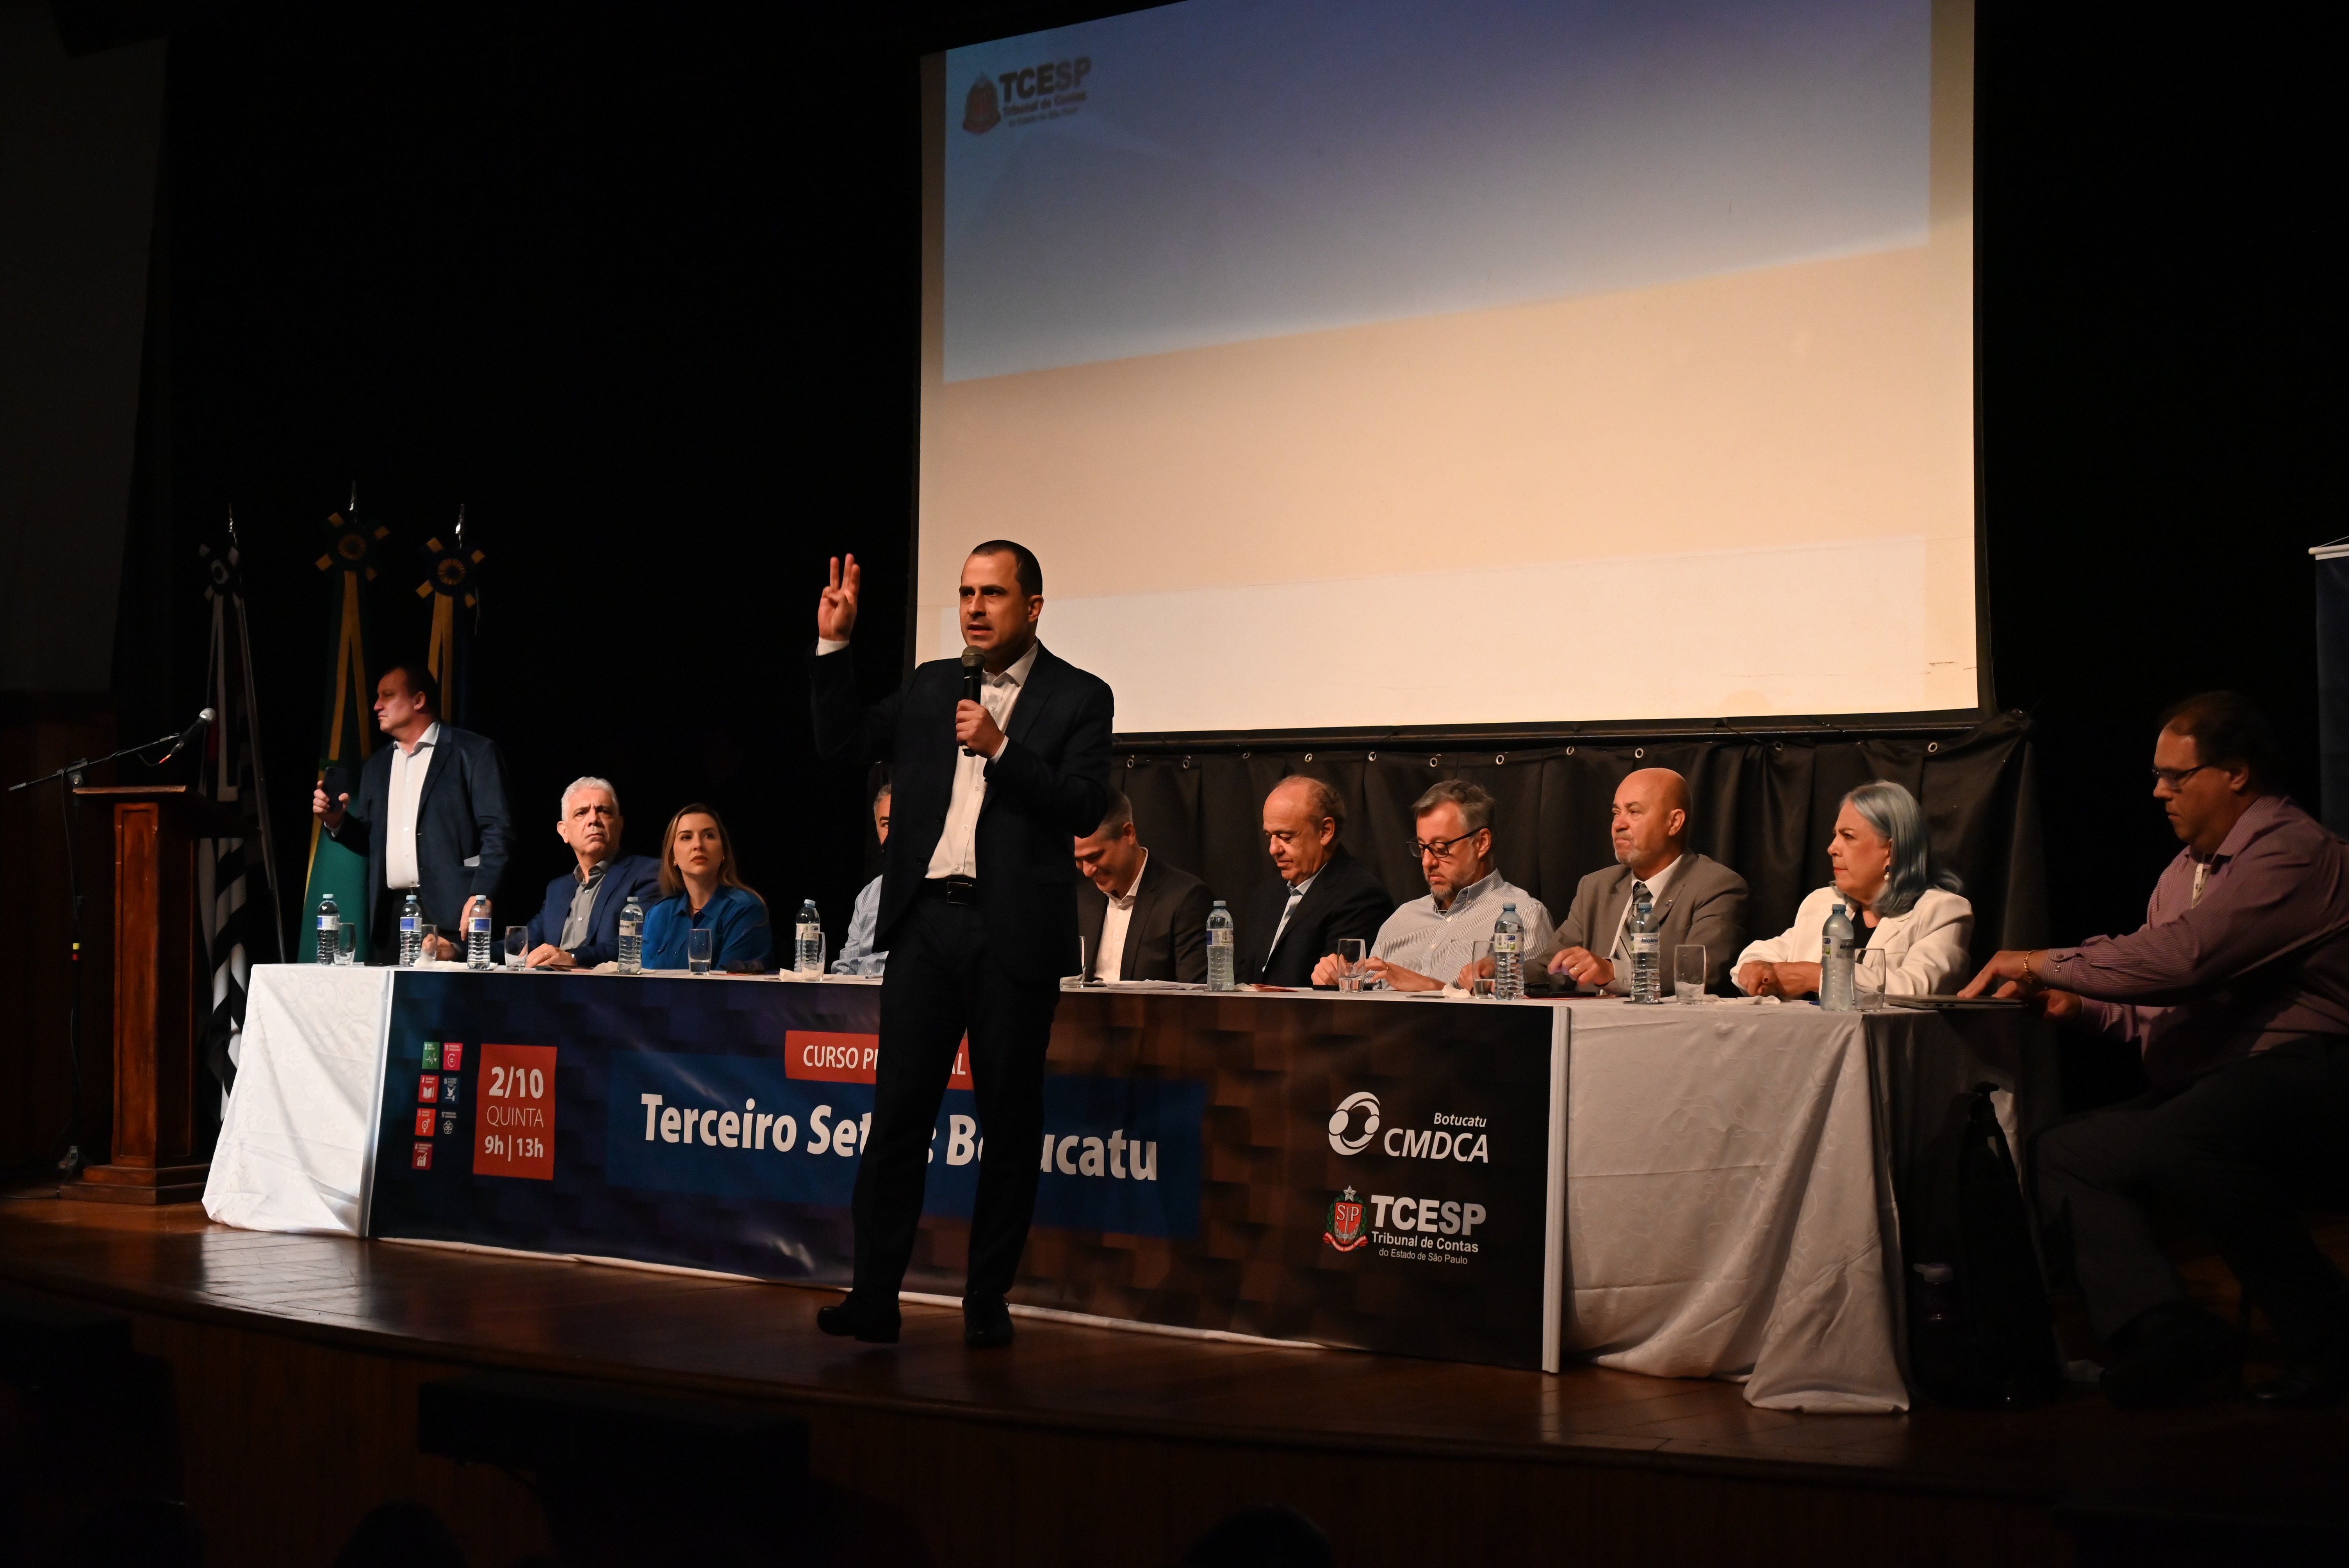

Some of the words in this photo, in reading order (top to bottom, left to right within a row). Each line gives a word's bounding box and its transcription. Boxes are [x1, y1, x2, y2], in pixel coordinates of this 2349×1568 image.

[999, 57, 1092, 103] TCESP
[803, 1045, 858, 1069] CURSO
[488, 1066, 544, 1099] 2/10
[487, 1106, 544, 1128] QUINTA
[641, 1093, 797, 1152] Terceiro
[1434, 1112, 1487, 1128] Botucatu
[485, 1135, 503, 1155] 9h
[517, 1138, 543, 1158] 13h
[1384, 1128, 1489, 1163] CMDCA
[1371, 1194, 1487, 1236] TCESP
[1372, 1231, 1418, 1247] Tribunal
[1420, 1236, 1433, 1249] de
[1436, 1237, 1479, 1253] Contas
[1379, 1248, 1389, 1256] do
[1391, 1249, 1415, 1259] Estado
[1417, 1252, 1426, 1261] de
[1428, 1253, 1442, 1262] São
[1445, 1254, 1468, 1265] Paulo
